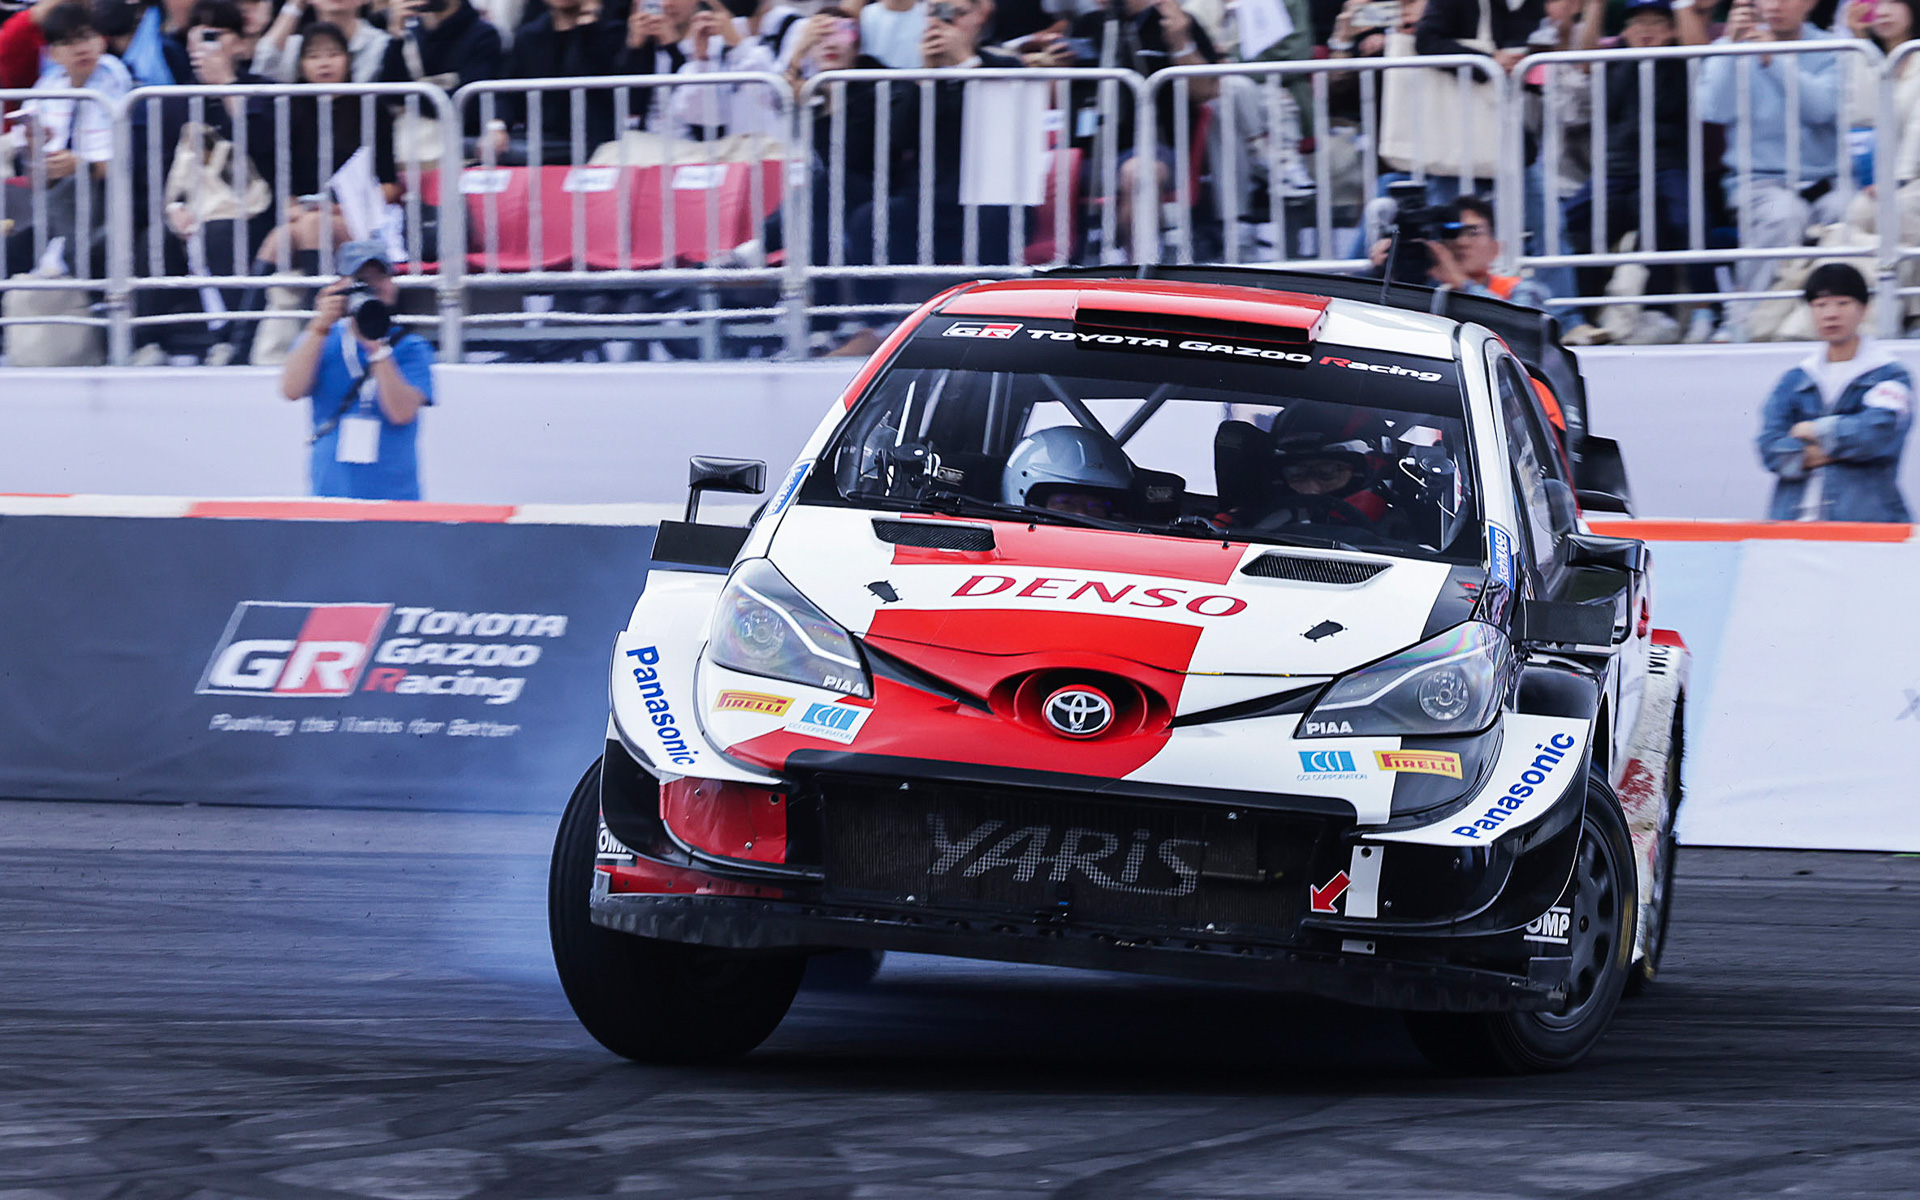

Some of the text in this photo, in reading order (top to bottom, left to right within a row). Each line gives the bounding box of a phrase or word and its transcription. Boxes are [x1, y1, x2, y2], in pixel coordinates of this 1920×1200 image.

[947, 326, 1443, 382] GR TOYOTA GAZOO Racing
[951, 575, 1248, 617] DENSO
[393, 606, 569, 638] TOYOTA
[374, 638, 543, 667] GAZOO
[361, 667, 527, 705] Racing
[822, 675, 865, 696] PIAA
[625, 645, 699, 766] Panasonic
[717, 691, 788, 713] PIRELLI
[812, 705, 848, 729] CCI
[1305, 721, 1354, 735] PIAA
[1309, 751, 1346, 772] CCI
[1380, 753, 1456, 774] PIRELLI
[1451, 732, 1575, 839] Panasonic
